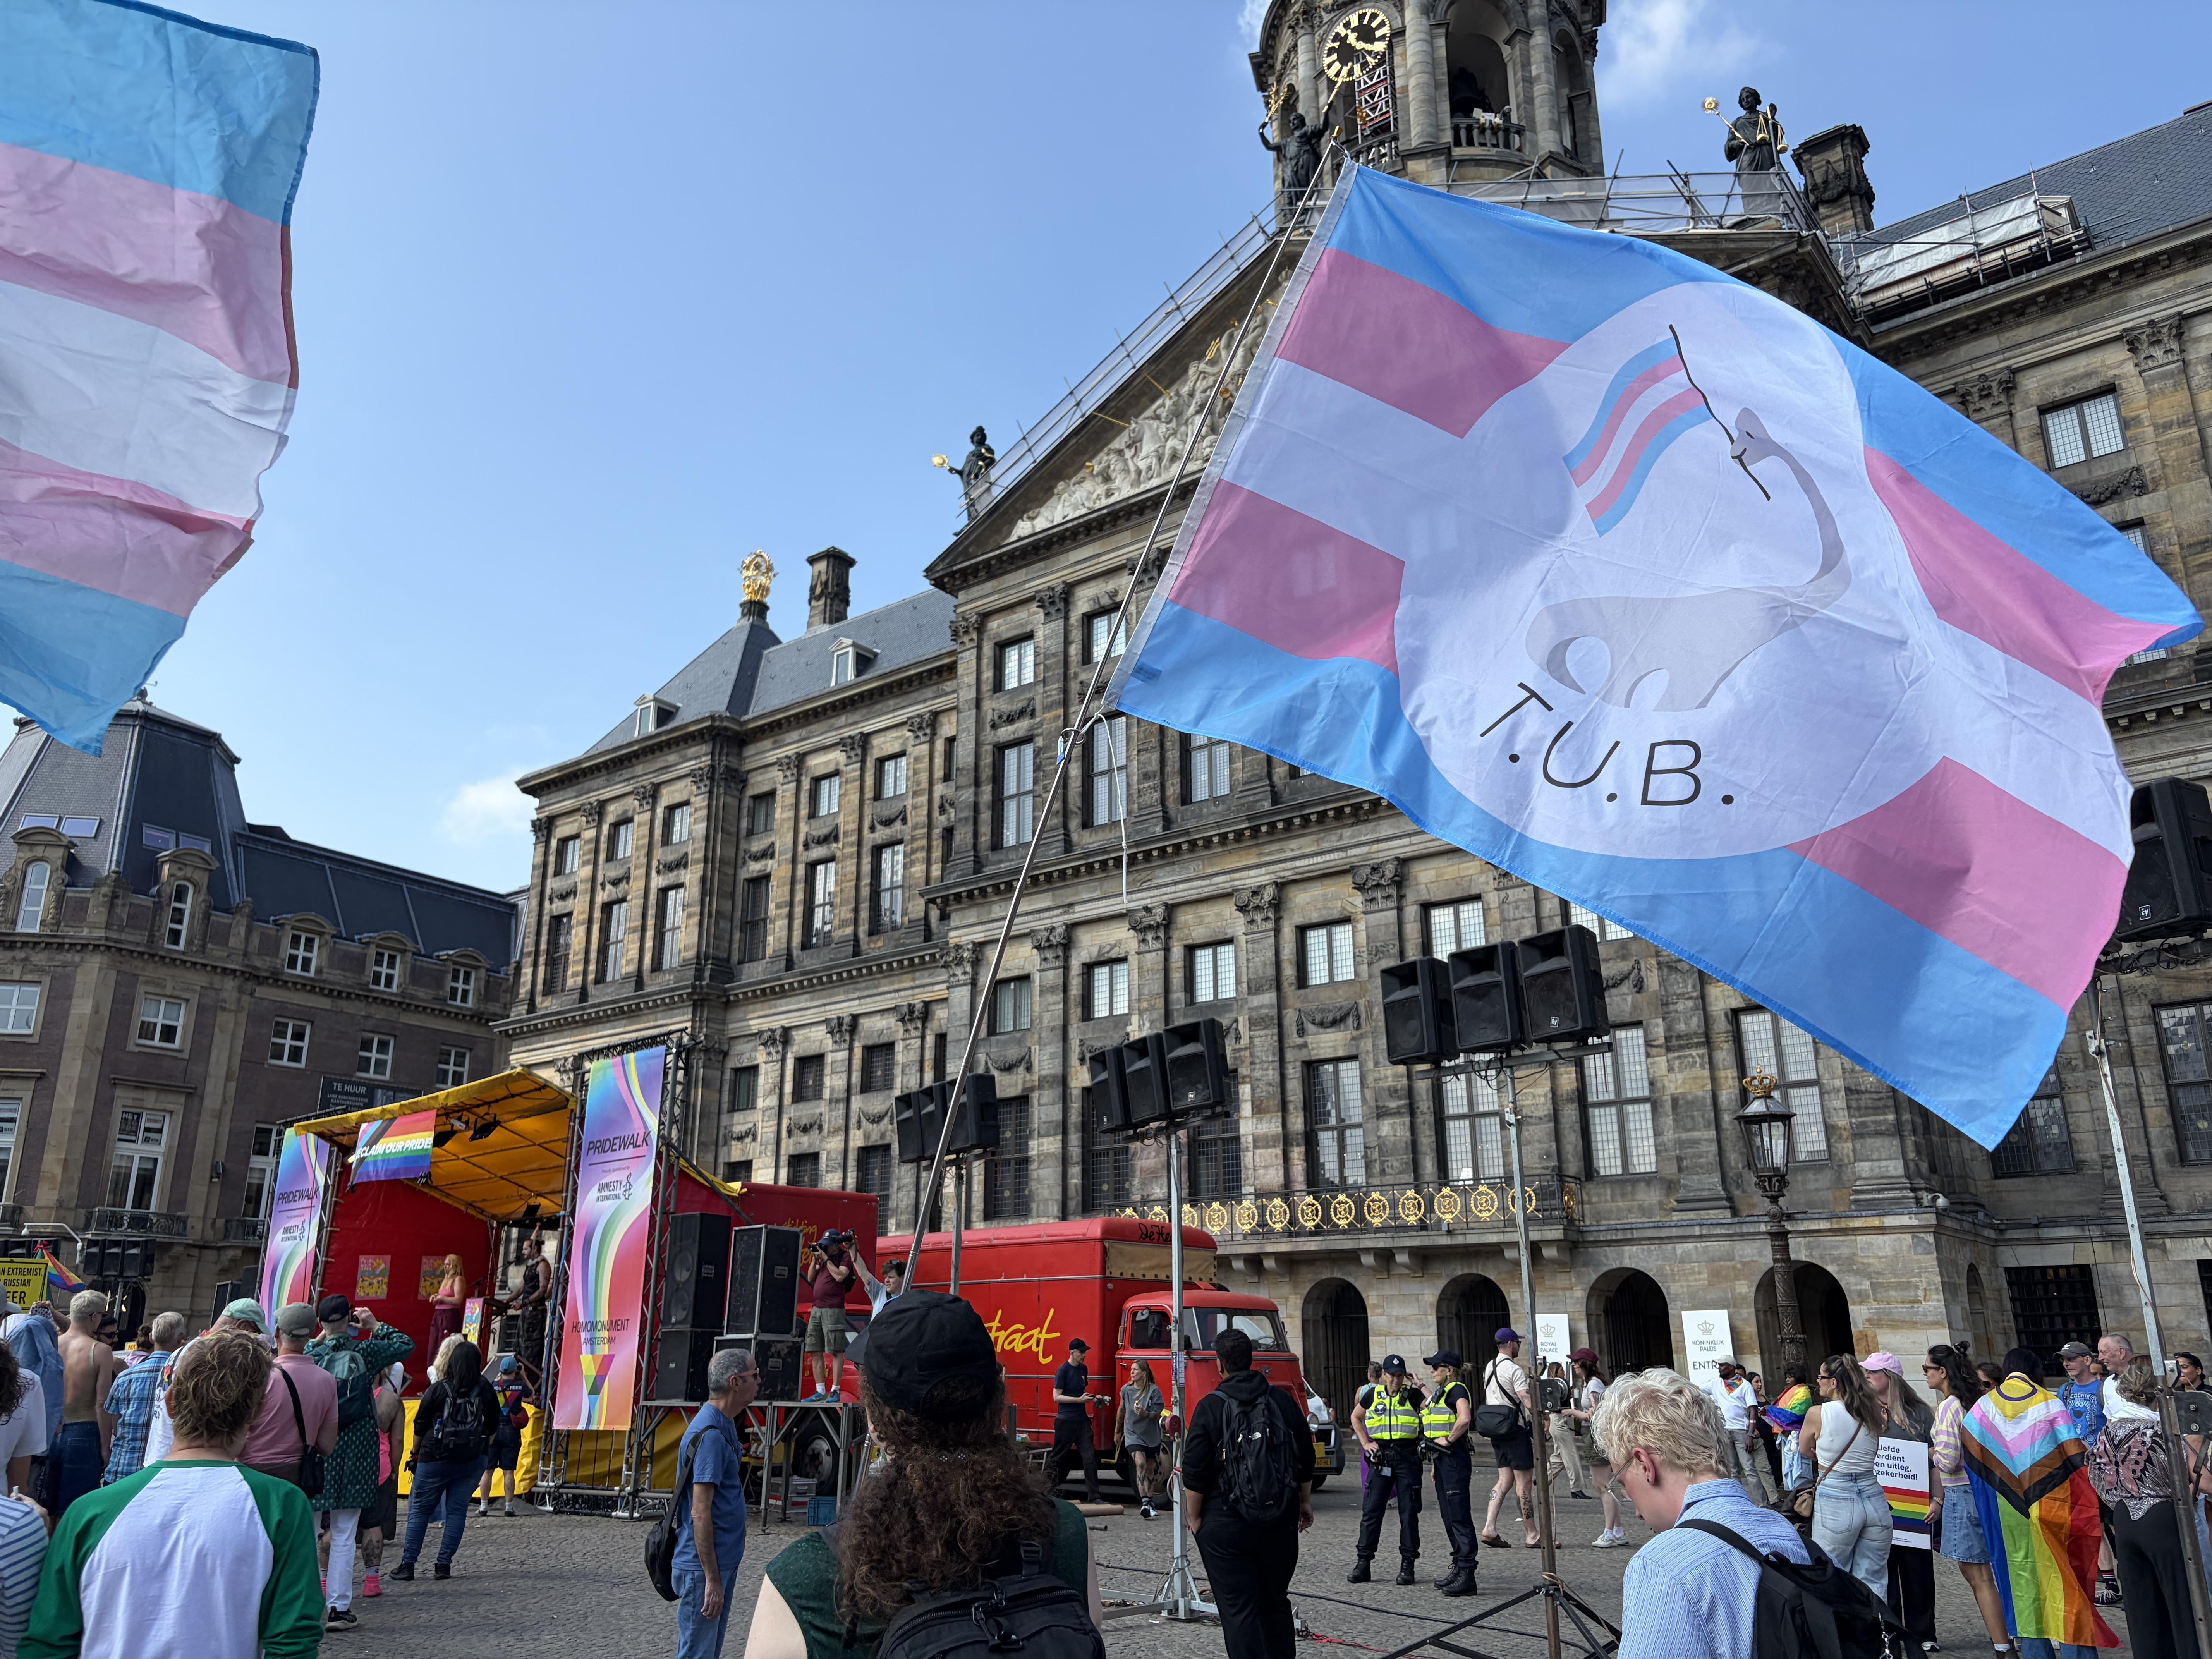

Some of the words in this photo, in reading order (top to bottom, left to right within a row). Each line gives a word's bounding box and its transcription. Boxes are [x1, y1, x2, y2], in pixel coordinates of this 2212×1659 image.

[333, 1082, 343, 1091] TE
[344, 1084, 366, 1094] HUUR
[385, 1140, 404, 1153] OUR
[403, 1137, 433, 1151] PRIDE
[586, 1130, 652, 1157] PRIDEWALK
[597, 1179, 623, 1194] AMNESTY
[277, 1186, 319, 1205] PRIDEWALK
[596, 1192, 621, 1202] INTERNATIONAL
[282, 1224, 300, 1235] AMNESTY
[7, 1267, 43, 1278] EXTREMIST,
[3, 1279, 31, 1287] RUSSIAN
[572, 1319, 630, 1333] HOMOMONUMENT
[582, 1336, 616, 1346] AMSTERDAM
[1887, 1463, 1911, 1472] uitleg,
